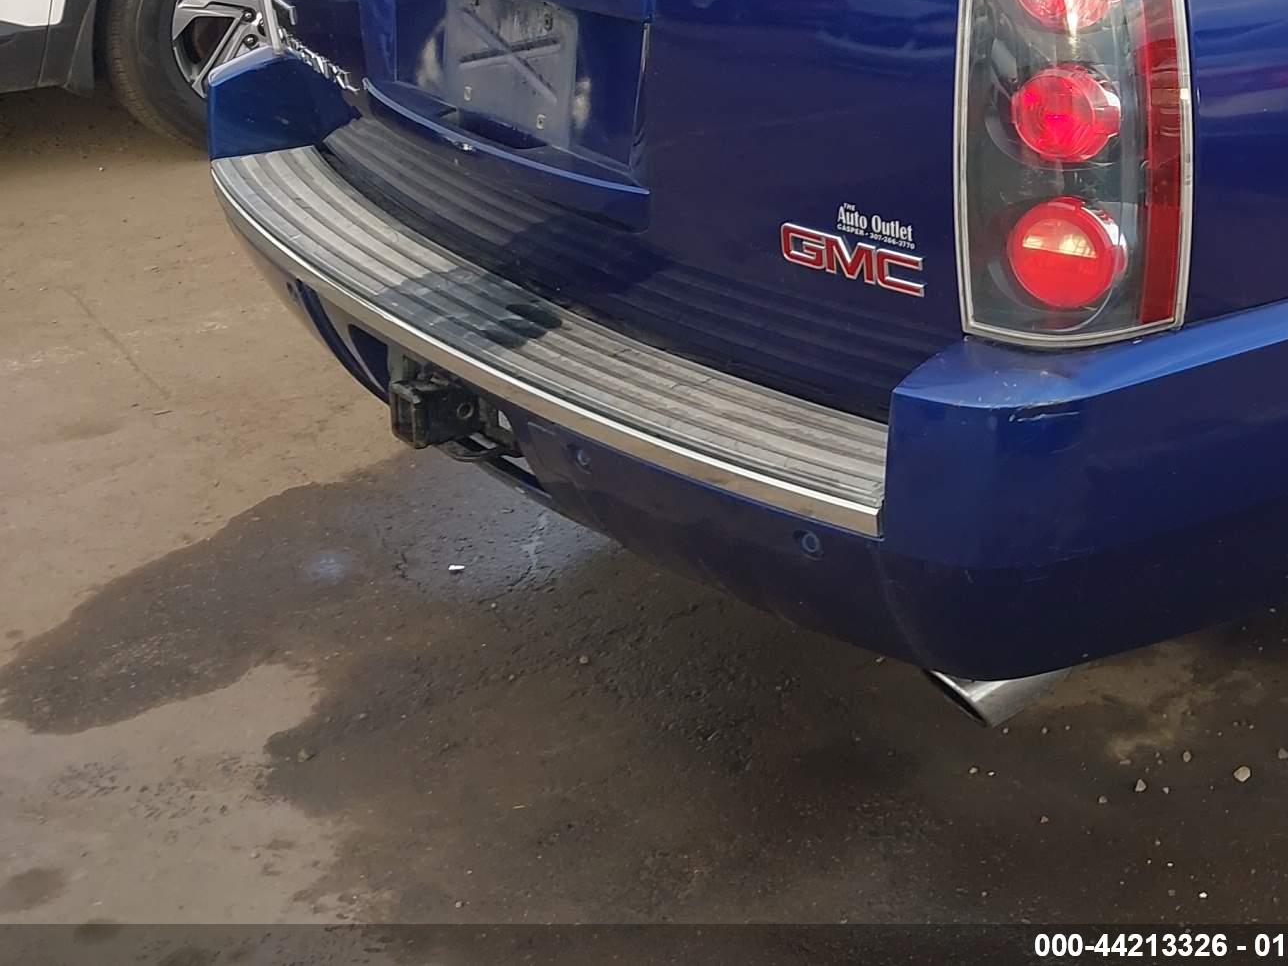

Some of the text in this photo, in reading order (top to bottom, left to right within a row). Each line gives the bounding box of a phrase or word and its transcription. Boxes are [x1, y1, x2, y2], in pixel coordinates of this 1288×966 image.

[843, 202, 856, 212] THE
[836, 224, 865, 236] CASPER
[837, 206, 913, 242] Auto Outlet
[781, 222, 926, 297] GMC
